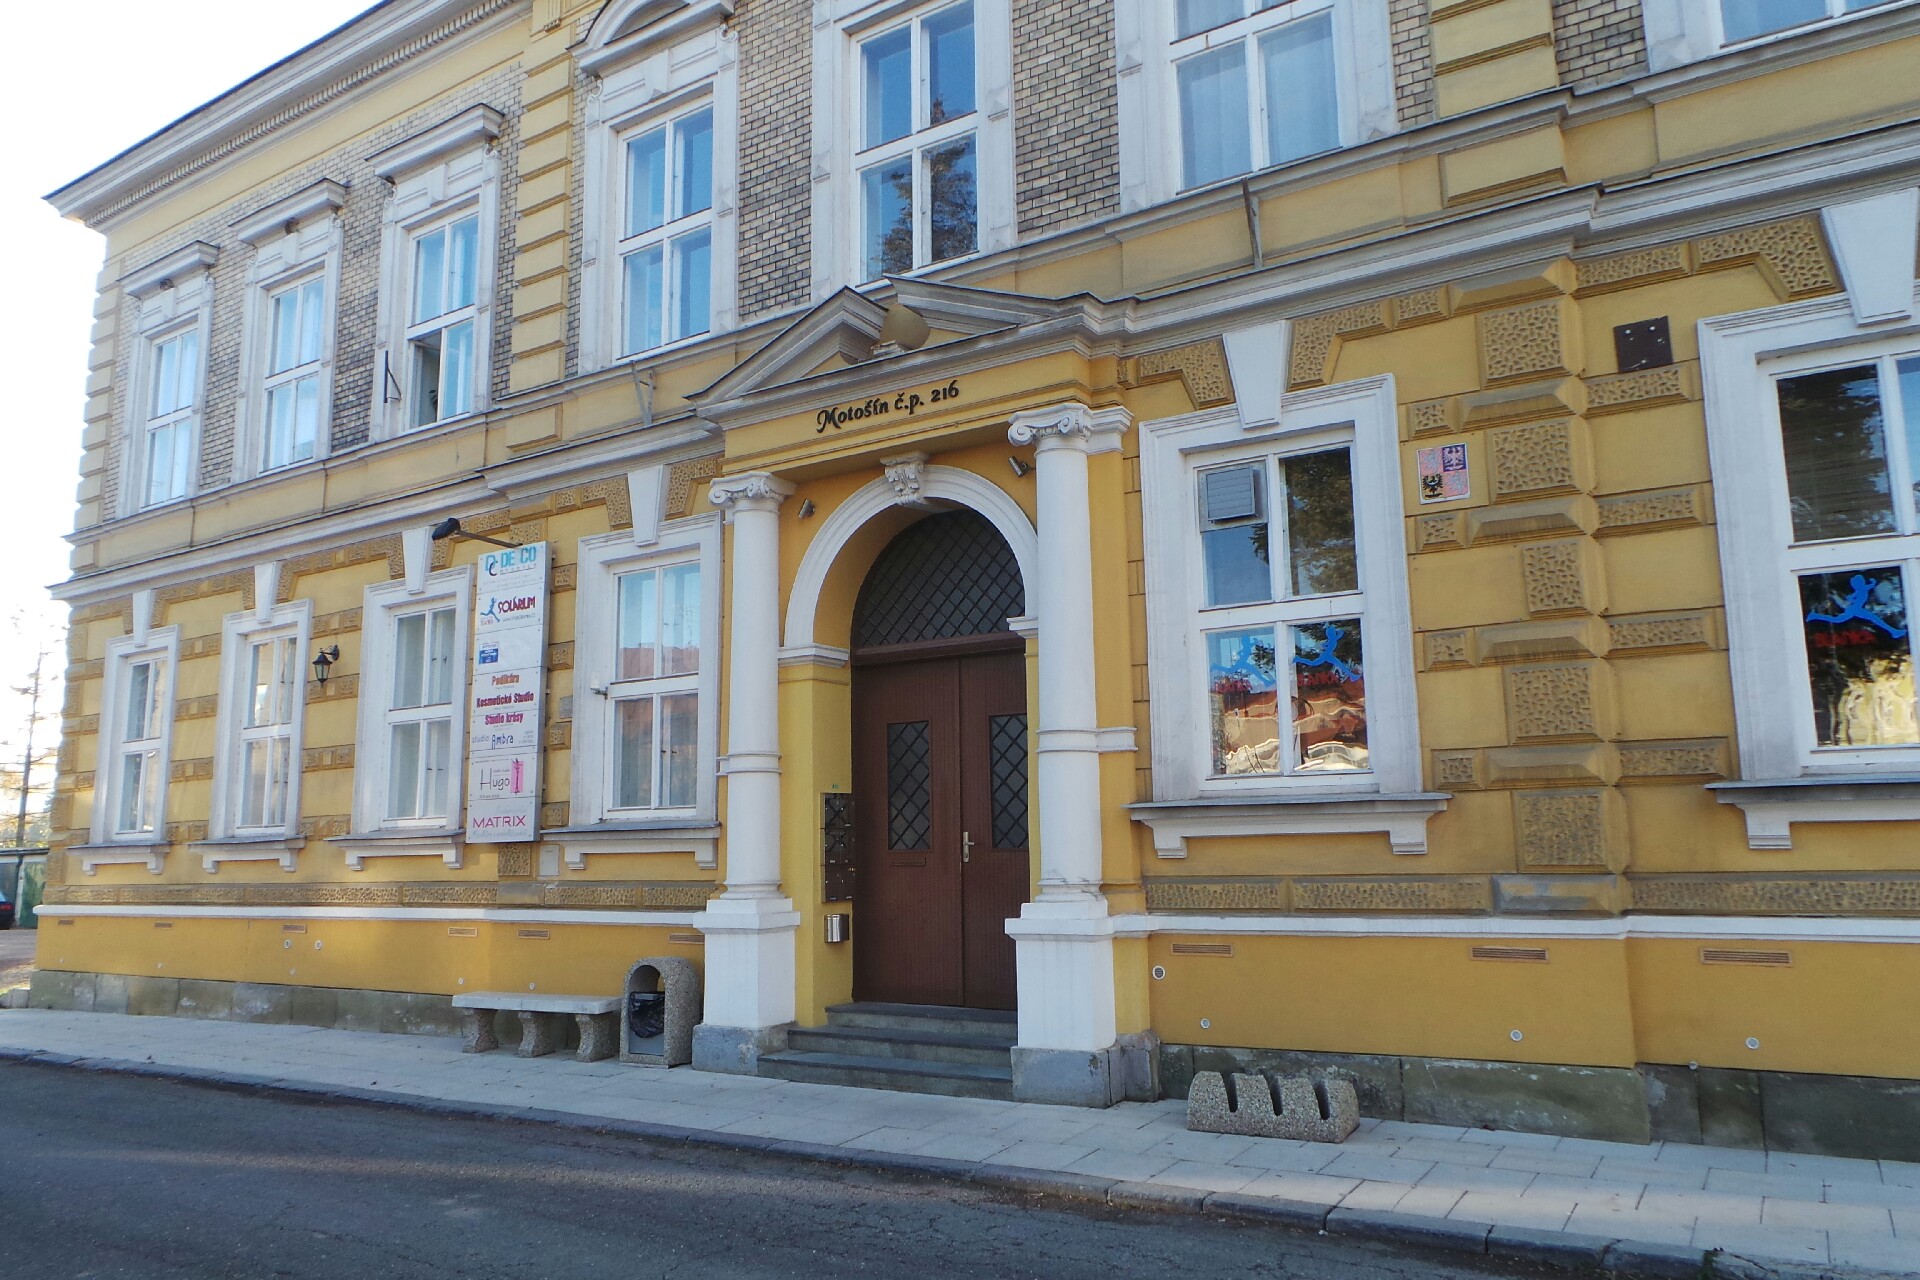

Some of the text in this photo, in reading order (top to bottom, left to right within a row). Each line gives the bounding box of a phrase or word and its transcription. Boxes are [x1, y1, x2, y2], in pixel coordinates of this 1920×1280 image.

[894, 392, 925, 415] č.p.
[930, 379, 960, 403] 216
[501, 546, 537, 568] DE CO
[476, 691, 534, 708] Kosmetické Studio
[485, 714, 504, 725] Studio
[472, 734, 490, 744] studio
[491, 734, 514, 750] Ambra
[480, 768, 510, 790] Hugo
[472, 815, 526, 828] MATRIX
